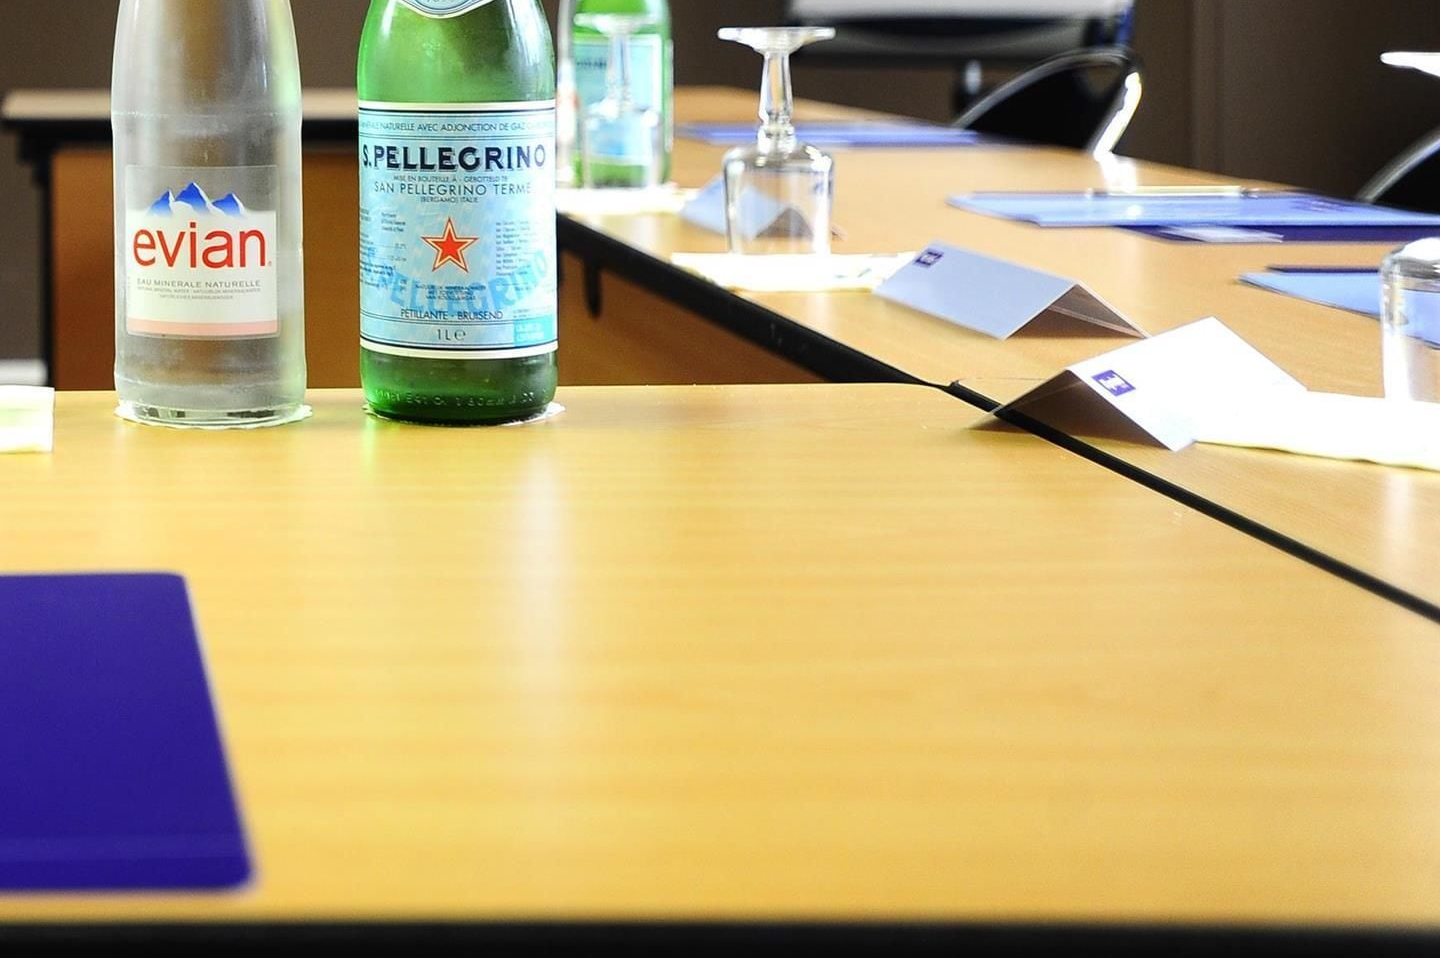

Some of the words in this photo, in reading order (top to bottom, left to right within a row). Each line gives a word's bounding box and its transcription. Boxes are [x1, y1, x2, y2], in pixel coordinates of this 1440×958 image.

[417, 122, 439, 132] AVEC
[440, 122, 497, 132] ADJONCTION
[498, 122, 510, 131] DE
[362, 143, 547, 172] S.PELLEGRINO
[374, 181, 395, 194] SAN
[399, 182, 488, 196] PELLEGRINO
[493, 182, 531, 196] TERME
[132, 221, 266, 270] evian
[136, 277, 152, 286] EAU
[205, 279, 261, 289] NATURELLE
[457, 309, 504, 321] BRUISEND
